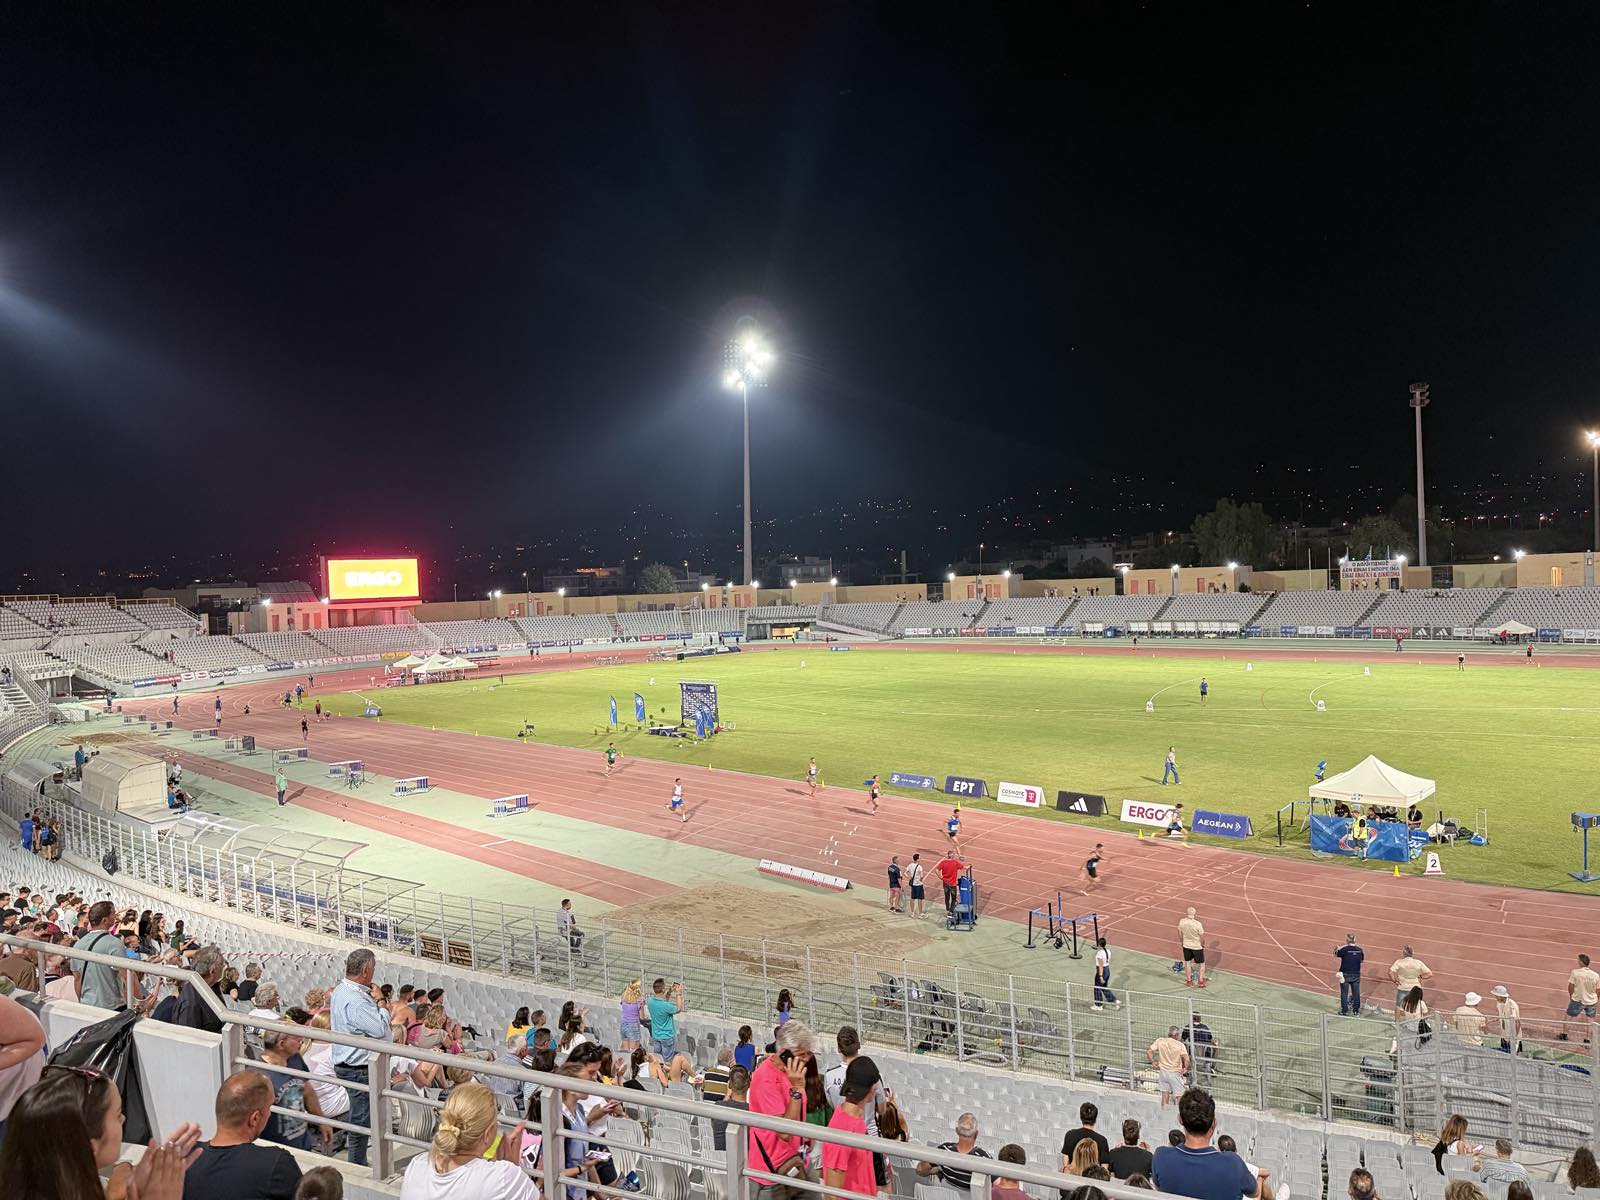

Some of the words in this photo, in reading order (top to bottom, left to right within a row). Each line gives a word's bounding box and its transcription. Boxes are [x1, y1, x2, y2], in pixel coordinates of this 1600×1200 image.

[345, 571, 402, 586] ERGO
[1128, 805, 1165, 821] ERGO
[1197, 818, 1234, 830] AEGEAN
[1213, 863, 1233, 871] 2
[1430, 859, 1437, 868] 2
